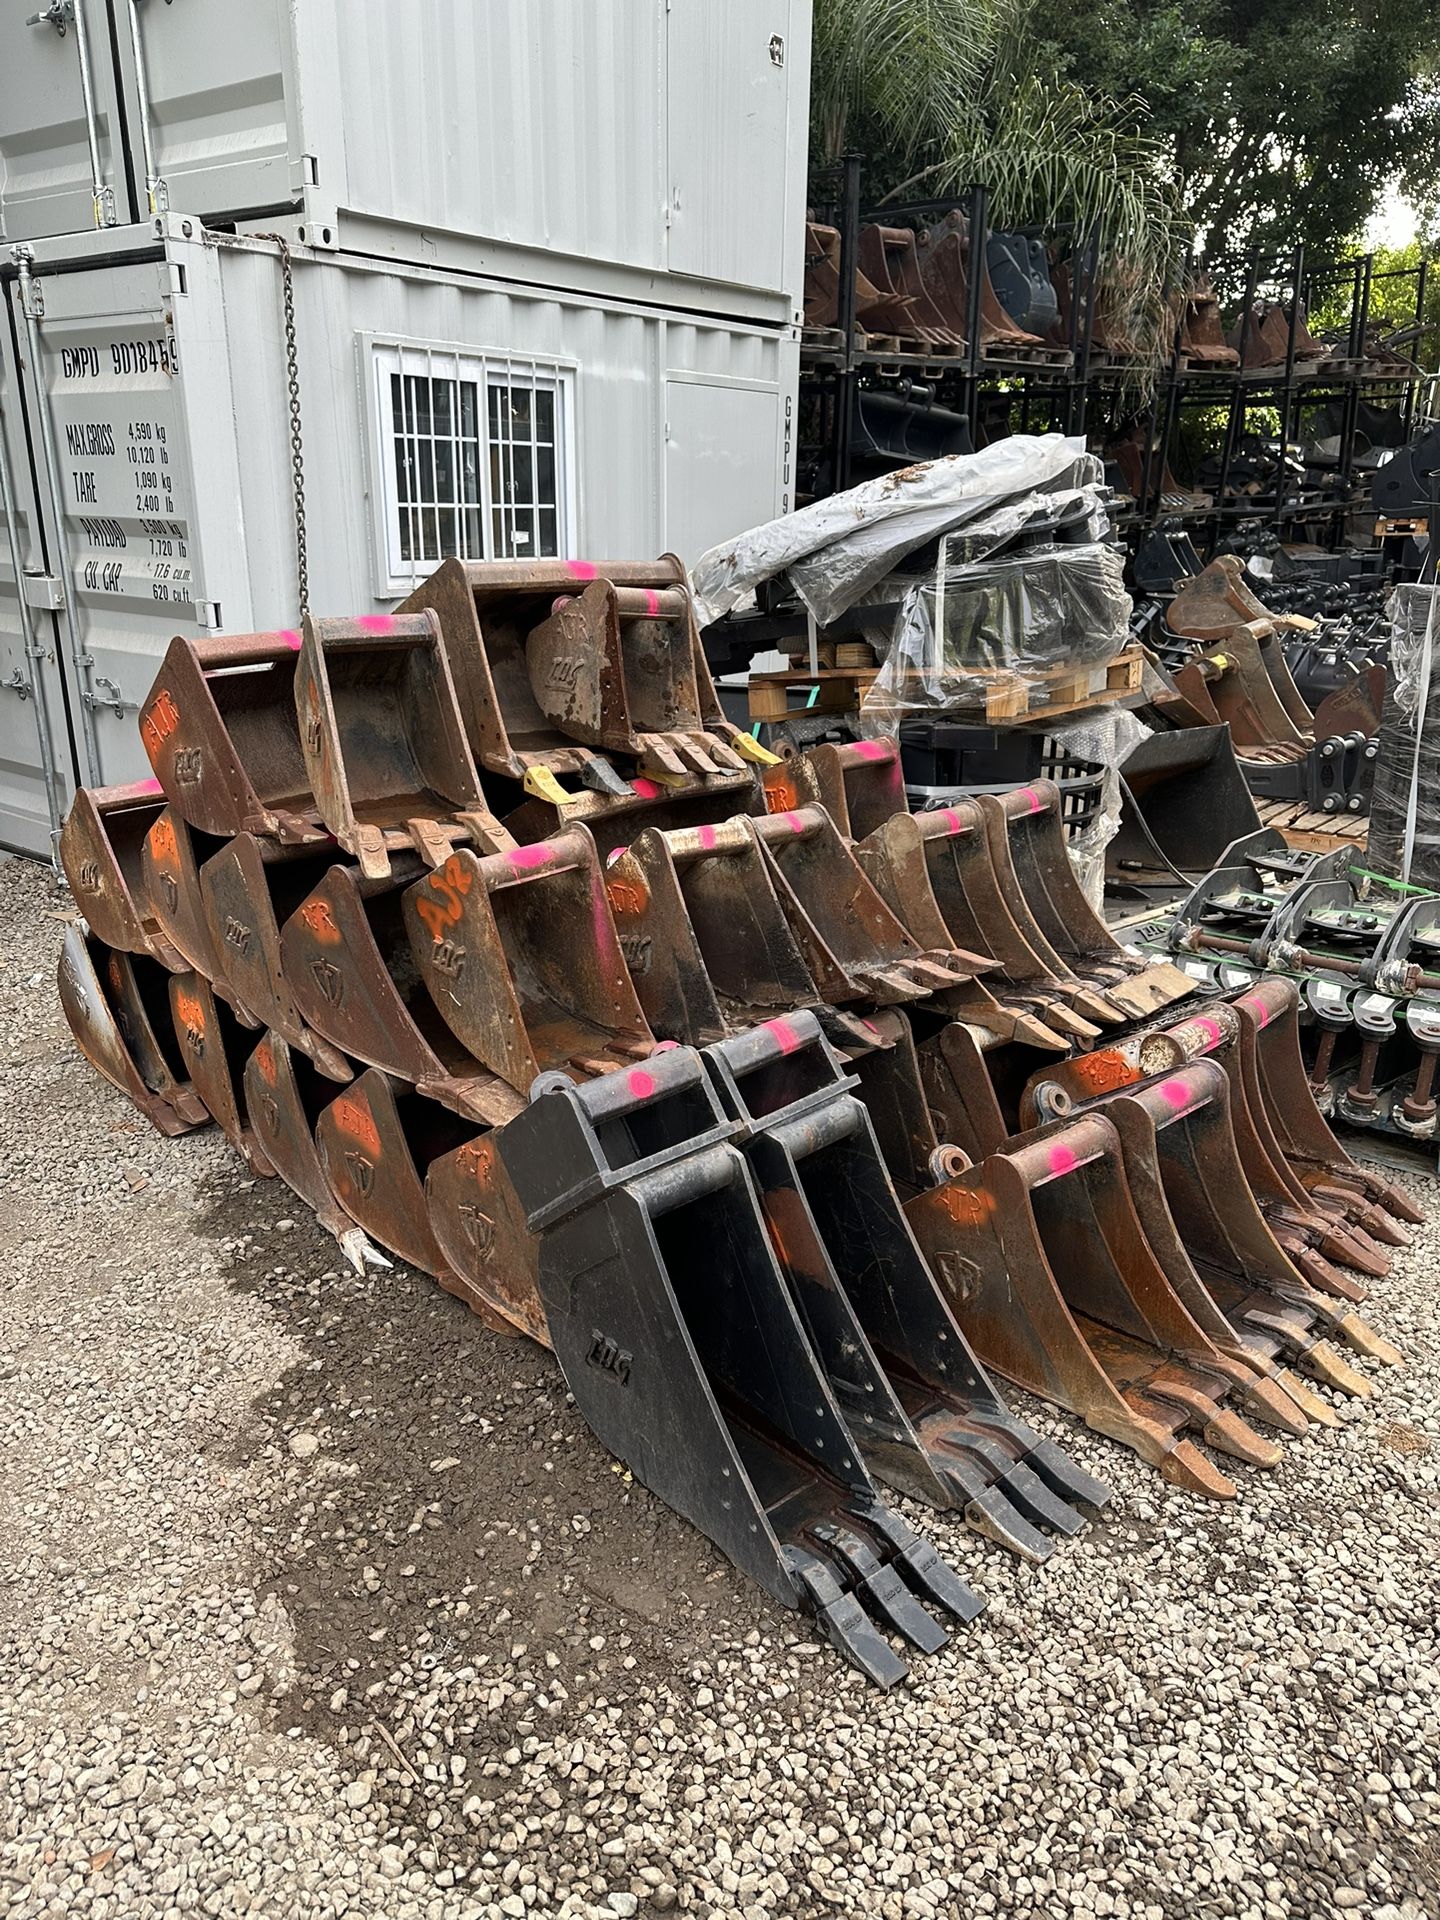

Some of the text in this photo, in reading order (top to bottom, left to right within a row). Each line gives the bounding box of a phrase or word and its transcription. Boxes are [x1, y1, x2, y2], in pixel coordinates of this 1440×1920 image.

[61, 346, 100, 378] GMPU
[65, 422, 167, 456] MAX.GROSS 4,590 kg
[783, 395, 792, 485] GMPU
[126, 446, 169, 466] 10,120 lb
[72, 471, 172, 503] TARE 1,090 kg
[136, 494, 174, 514] 2,400 lb
[79, 517, 184, 549] PAYLOAD 3,500 kg
[148, 538, 187, 558] 7,720 lb
[84, 561, 101, 591] CU.
[102, 562, 125, 593] CAP.
[153, 562, 171, 579] 17.6
[152, 583, 169, 602] 620
